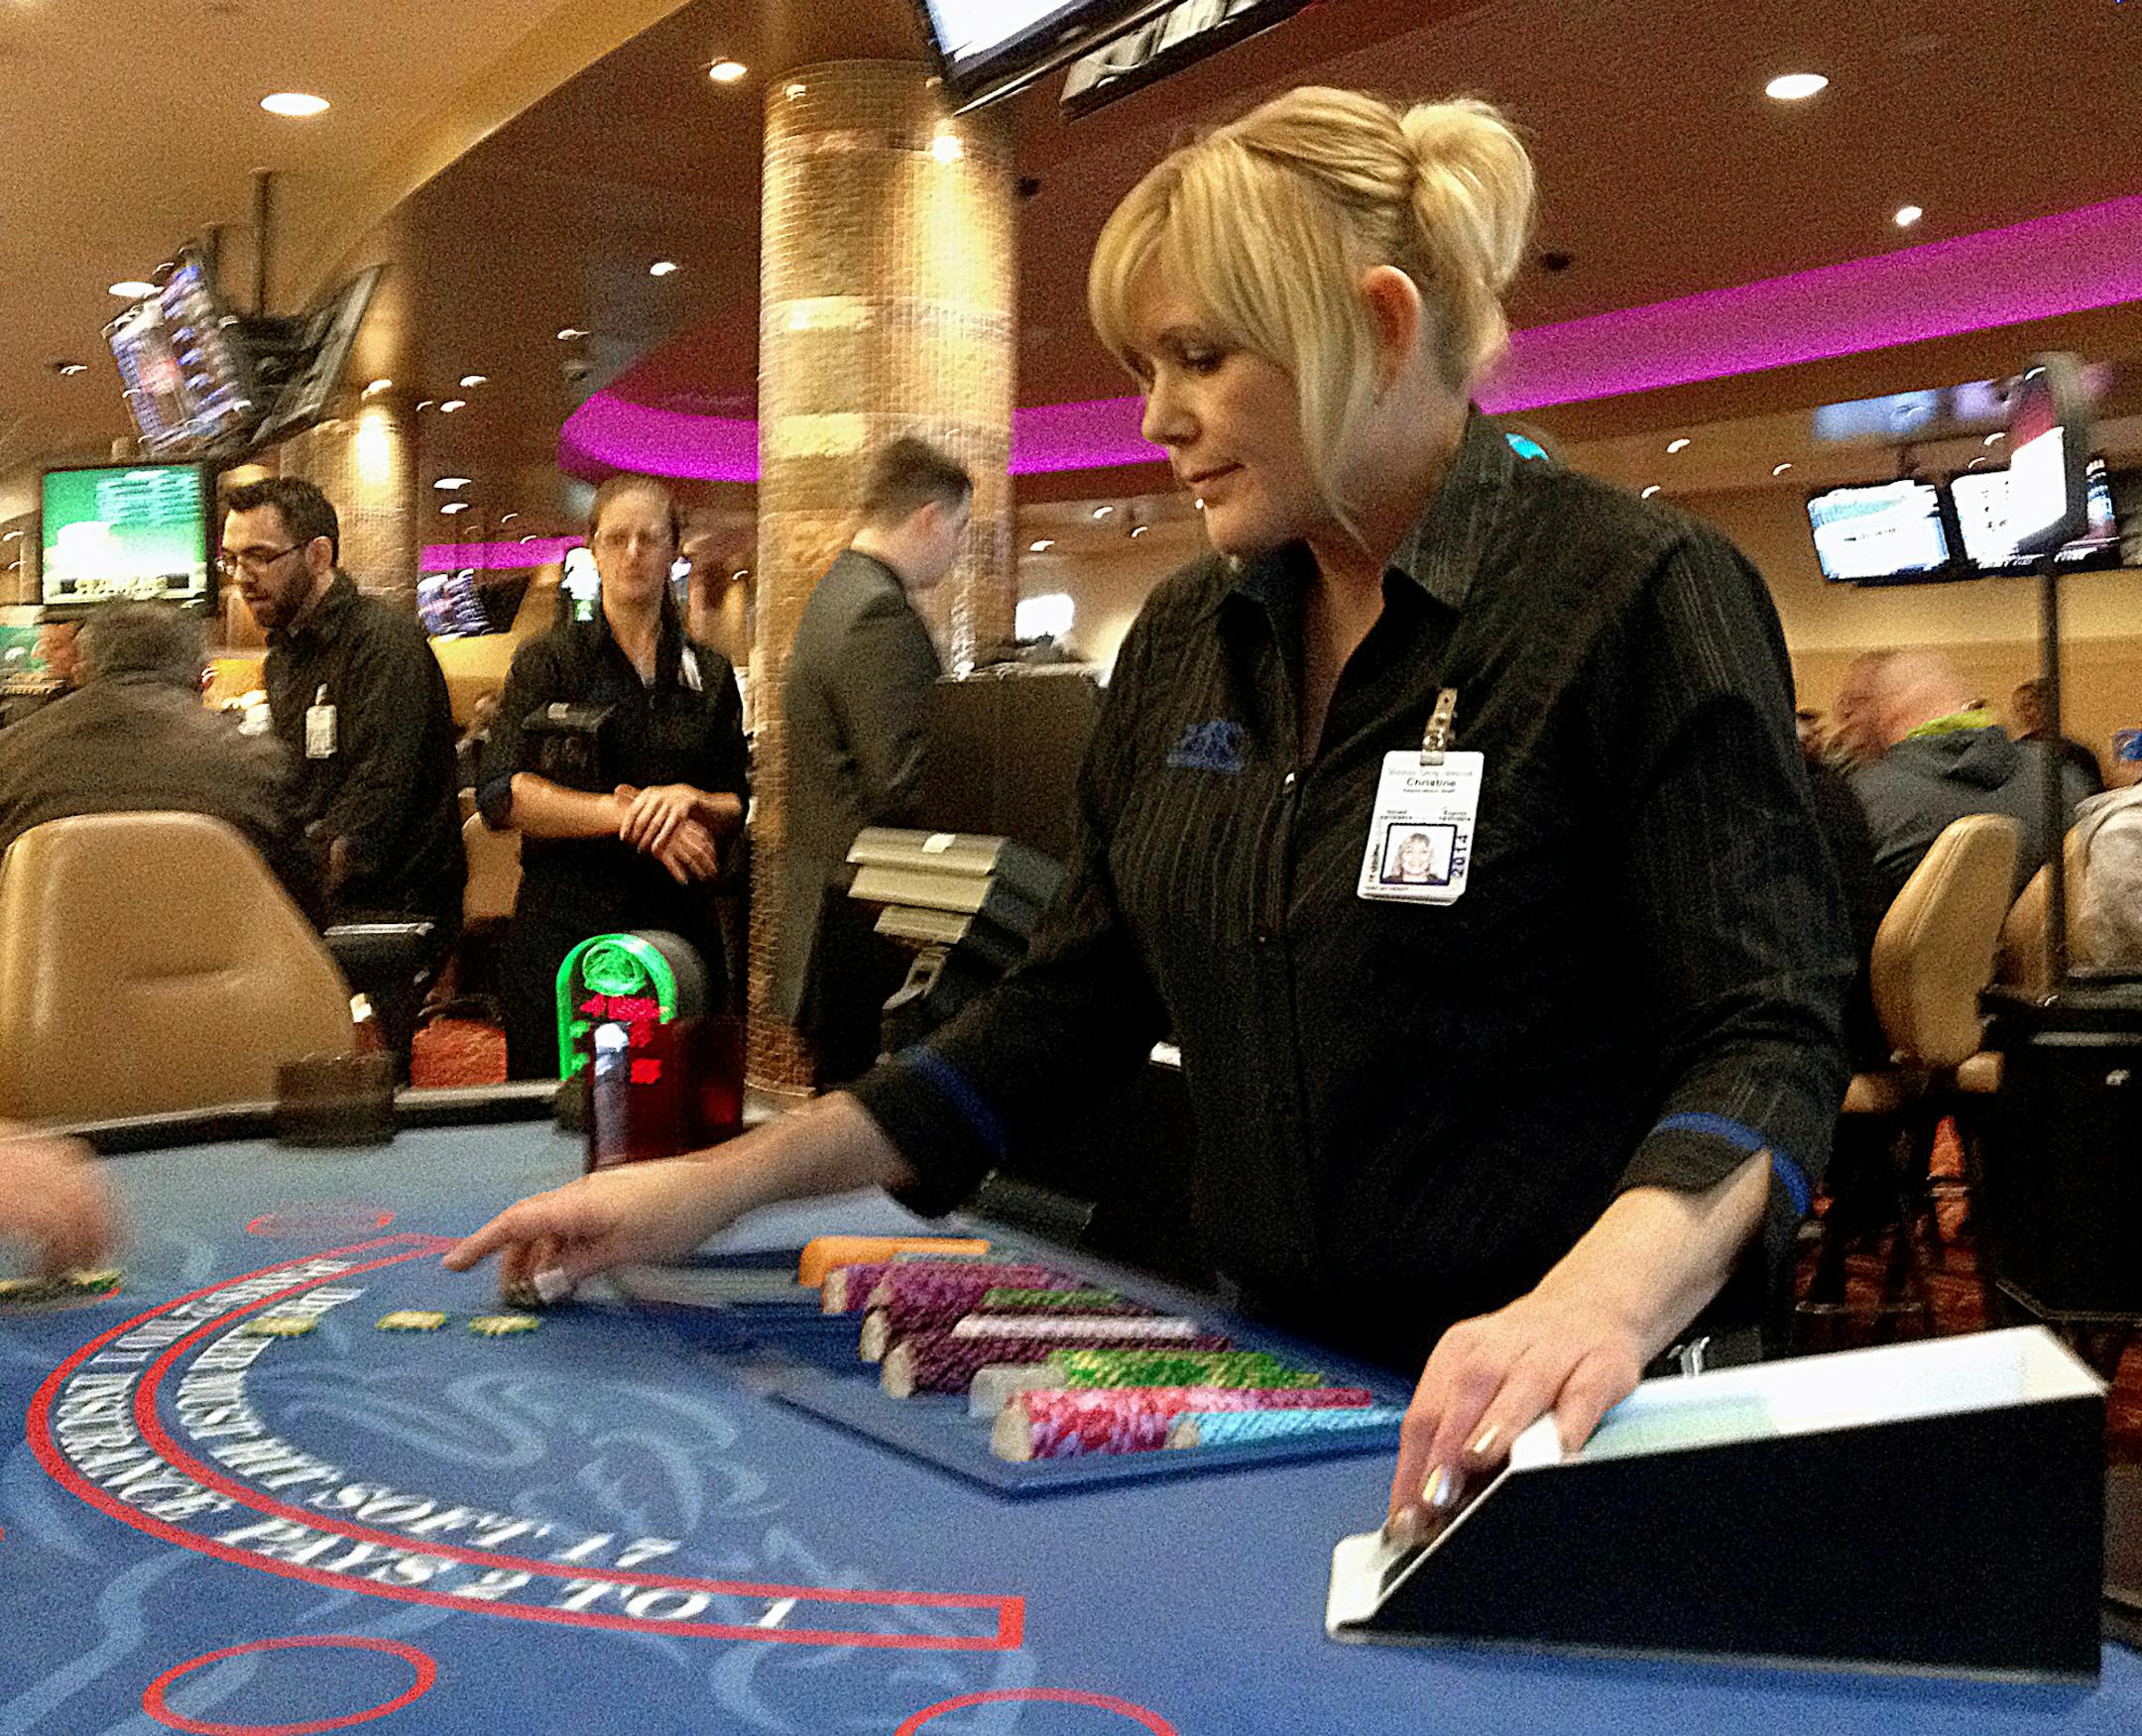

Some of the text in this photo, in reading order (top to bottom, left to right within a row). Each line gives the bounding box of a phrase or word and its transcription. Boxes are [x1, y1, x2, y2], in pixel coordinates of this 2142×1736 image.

[1406, 777, 1457, 787] Christine
[1451, 834, 1469, 878] 2014
[56, 1372, 235, 1522] INSURANCE
[212, 1517, 457, 1585] PAYS
[449, 1569, 532, 1601] 2
[552, 1578, 712, 1621] TO
[750, 1596, 797, 1629] 1
[304, 1483, 551, 1548] SOFT
[549, 1532, 681, 1568] 17
